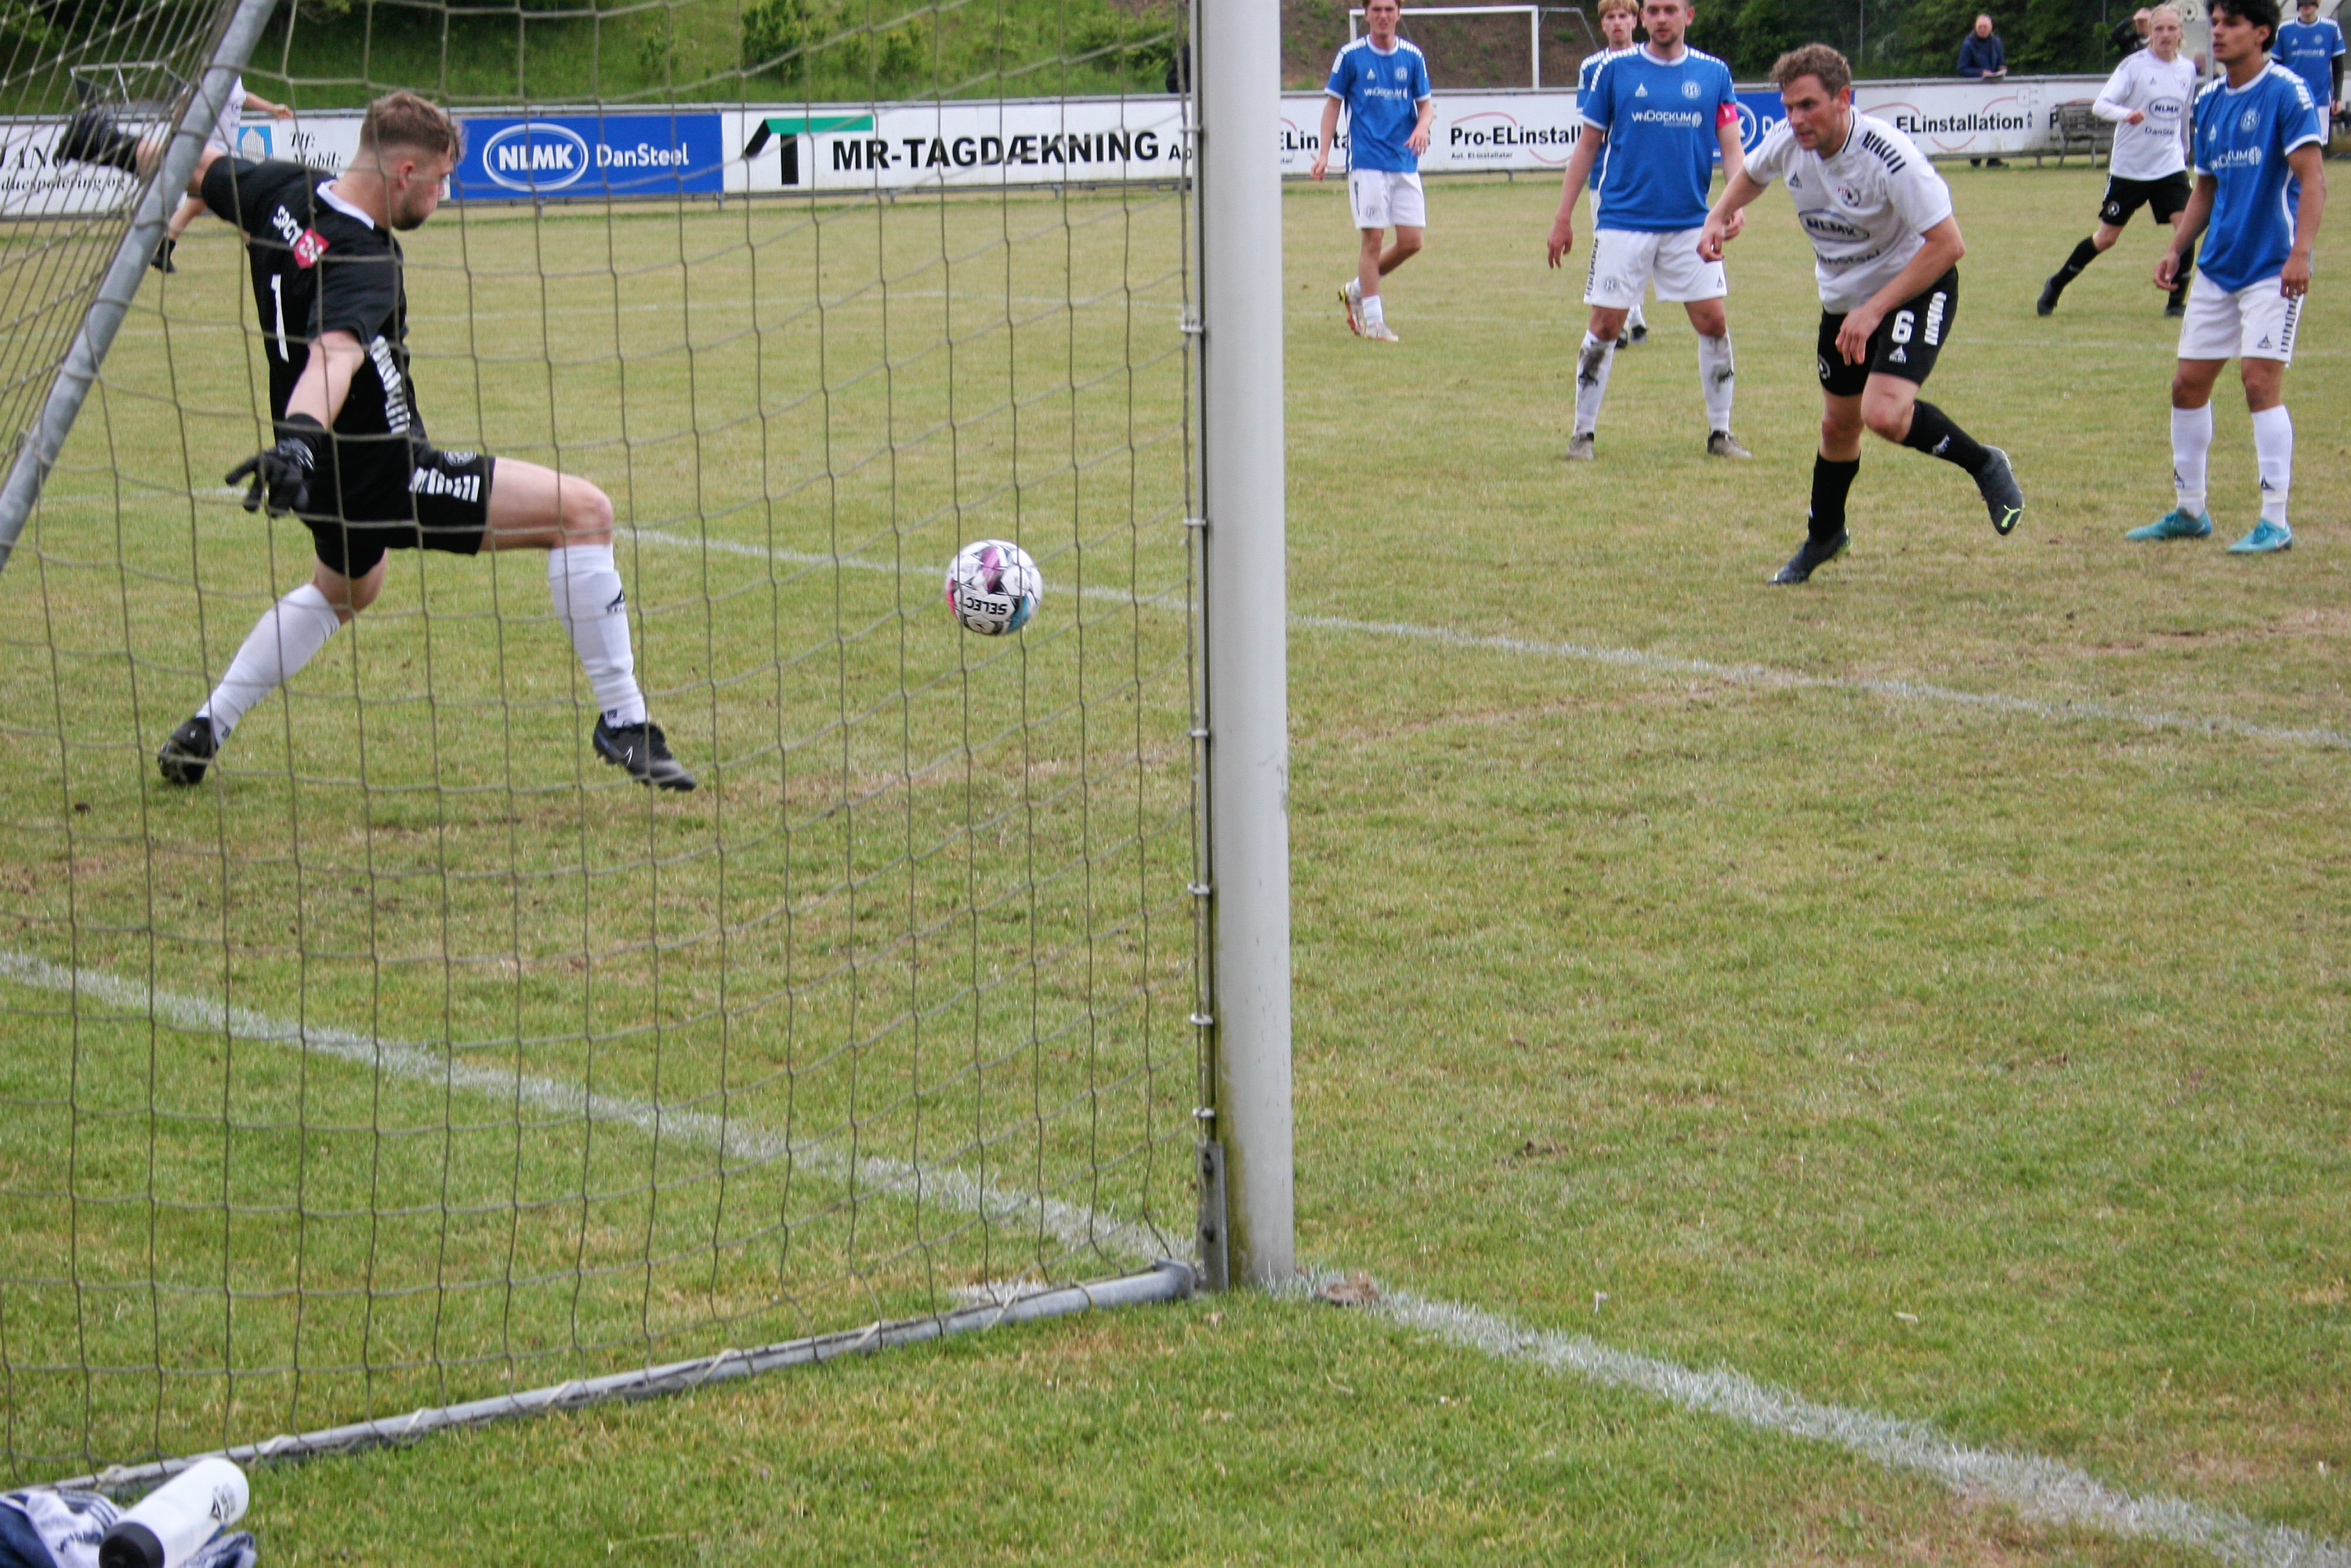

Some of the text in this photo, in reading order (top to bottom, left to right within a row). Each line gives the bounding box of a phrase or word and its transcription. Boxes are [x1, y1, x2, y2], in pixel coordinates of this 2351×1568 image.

[290, 132, 315, 150] Tlf:
[596, 142, 690, 167] DanSteel
[833, 130, 1159, 171] MR-TAGDÆKNING
[498, 143, 574, 171] NLMK
[271, 274, 290, 363] 1
[1891, 310, 1914, 345] 6
